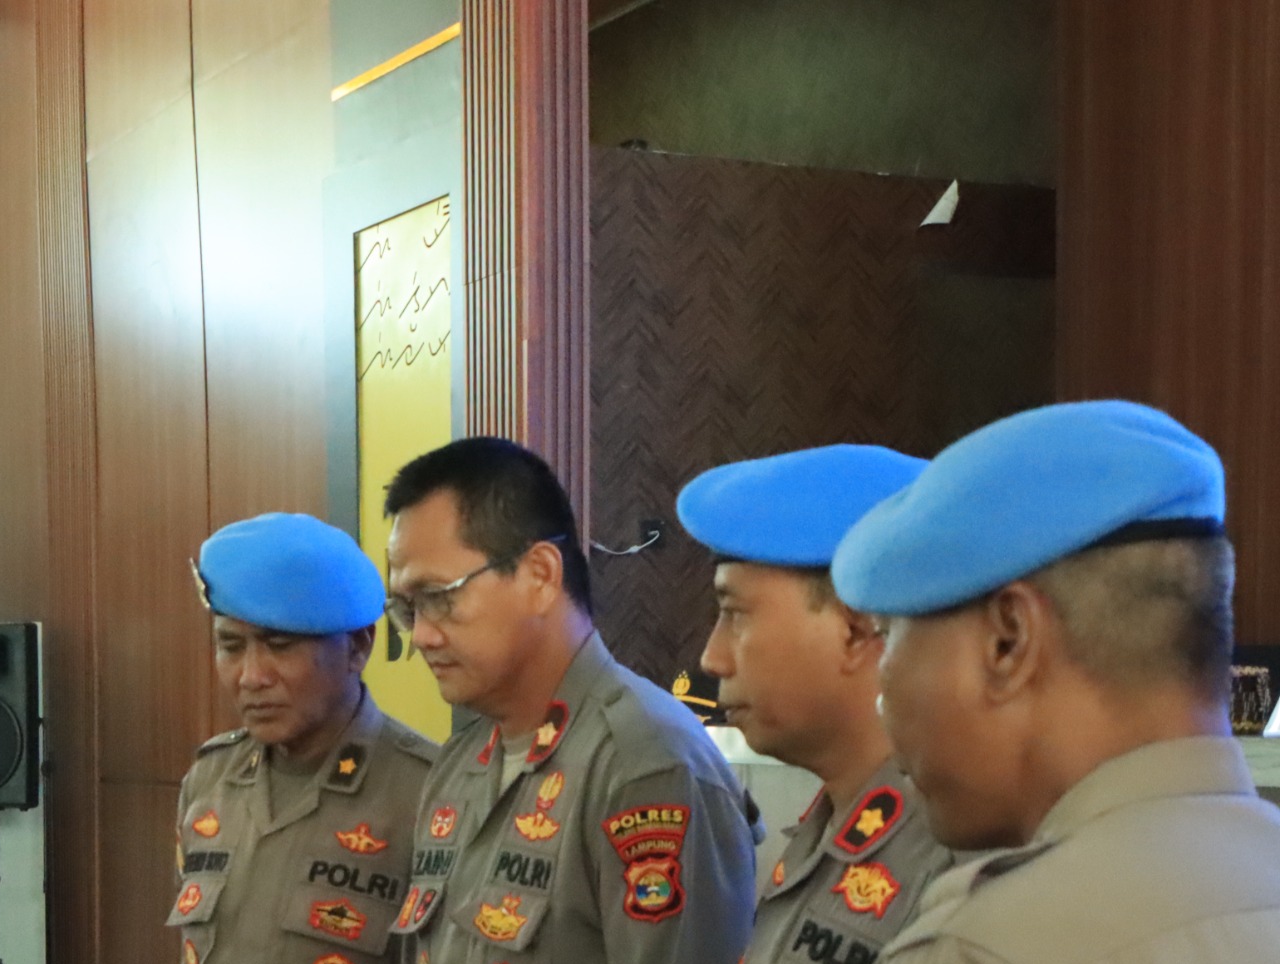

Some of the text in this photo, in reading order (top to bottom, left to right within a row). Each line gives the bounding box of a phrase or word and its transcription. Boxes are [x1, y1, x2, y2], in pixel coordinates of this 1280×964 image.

[609, 809, 683, 835] POLRES
[624, 840, 677, 857] LAMPUNG
[308, 860, 399, 901] POLRI
[494, 851, 553, 890] POLRI
